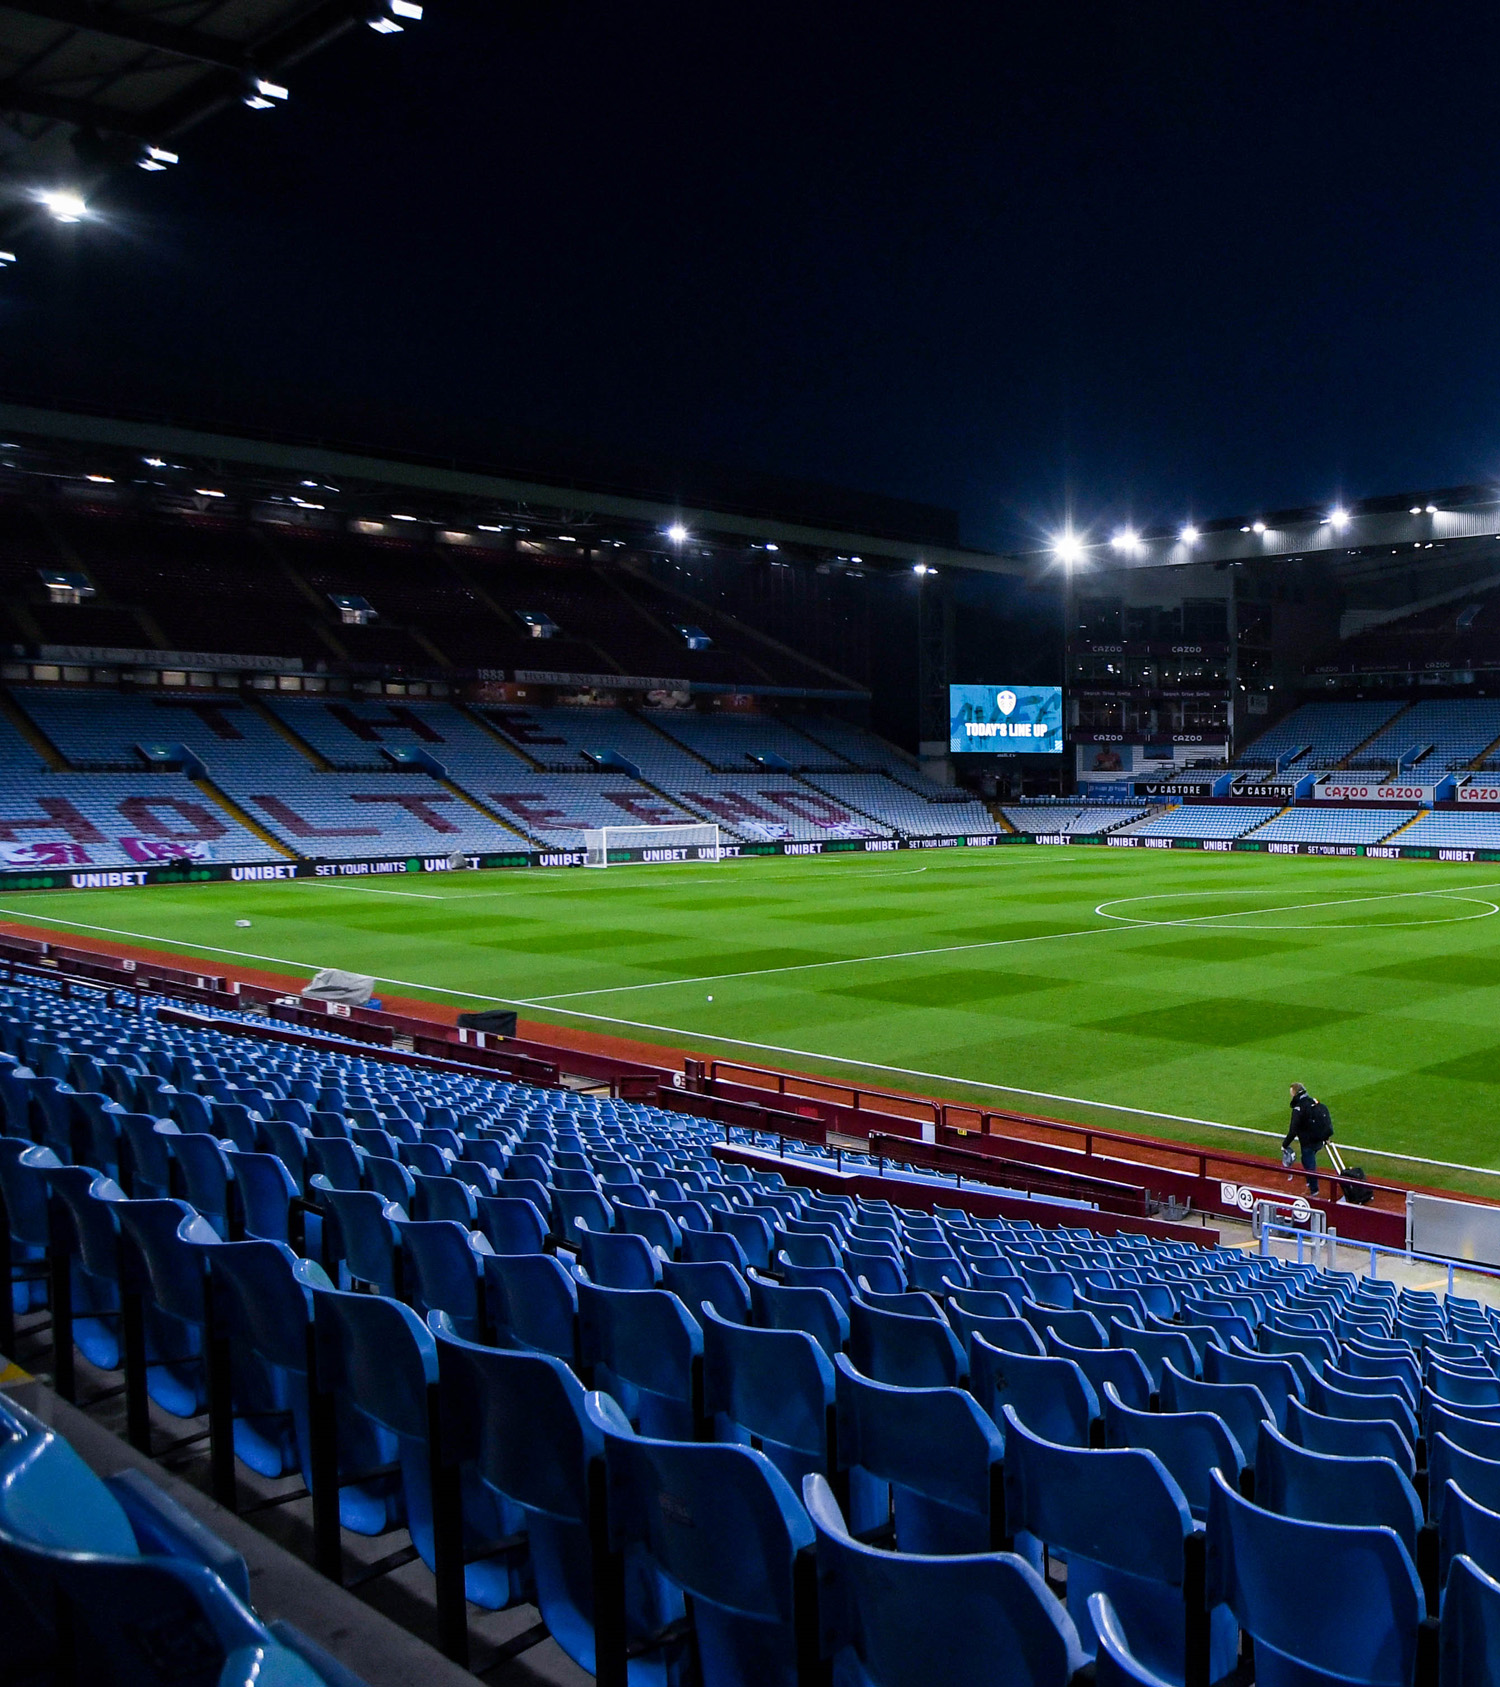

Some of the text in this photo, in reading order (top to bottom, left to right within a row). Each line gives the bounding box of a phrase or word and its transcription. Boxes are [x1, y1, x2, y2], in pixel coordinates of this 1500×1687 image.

[477, 668, 505, 681] 1888
[965, 722, 1048, 738] TODAY'S LINE UP
[1093, 734, 1123, 742] CAZOO
[1160, 785, 1201, 795] CASTORE
[1247, 786, 1293, 796] CASTORE
[1324, 786, 1423, 799] CAZOO CAZOO
[865, 840, 900, 851] UNIBET
[909, 838, 958, 849] SET YOUR LIMITS
[1035, 835, 1071, 845] UNIBET
[1107, 837, 1139, 847] UNIBET
[1144, 838, 1173, 849] UNIBET
[1203, 840, 1233, 851] UNIBET
[784, 843, 822, 855] UNIBET
[1267, 842, 1300, 854] UNIBET
[1307, 845, 1319, 855] SET
[1336, 846, 1356, 856] LIMITS
[1366, 847, 1400, 859] UNIBET
[539, 853, 589, 867] UNIBET
[642, 848, 688, 861] UNIBET
[1438, 849, 1475, 861] UNIBET
[230, 865, 298, 881] UNIBET
[315, 862, 407, 876] SET YOUR LIMITS
[71, 871, 148, 888] UNIBET
[1240, 1193, 1252, 1202] Q3
